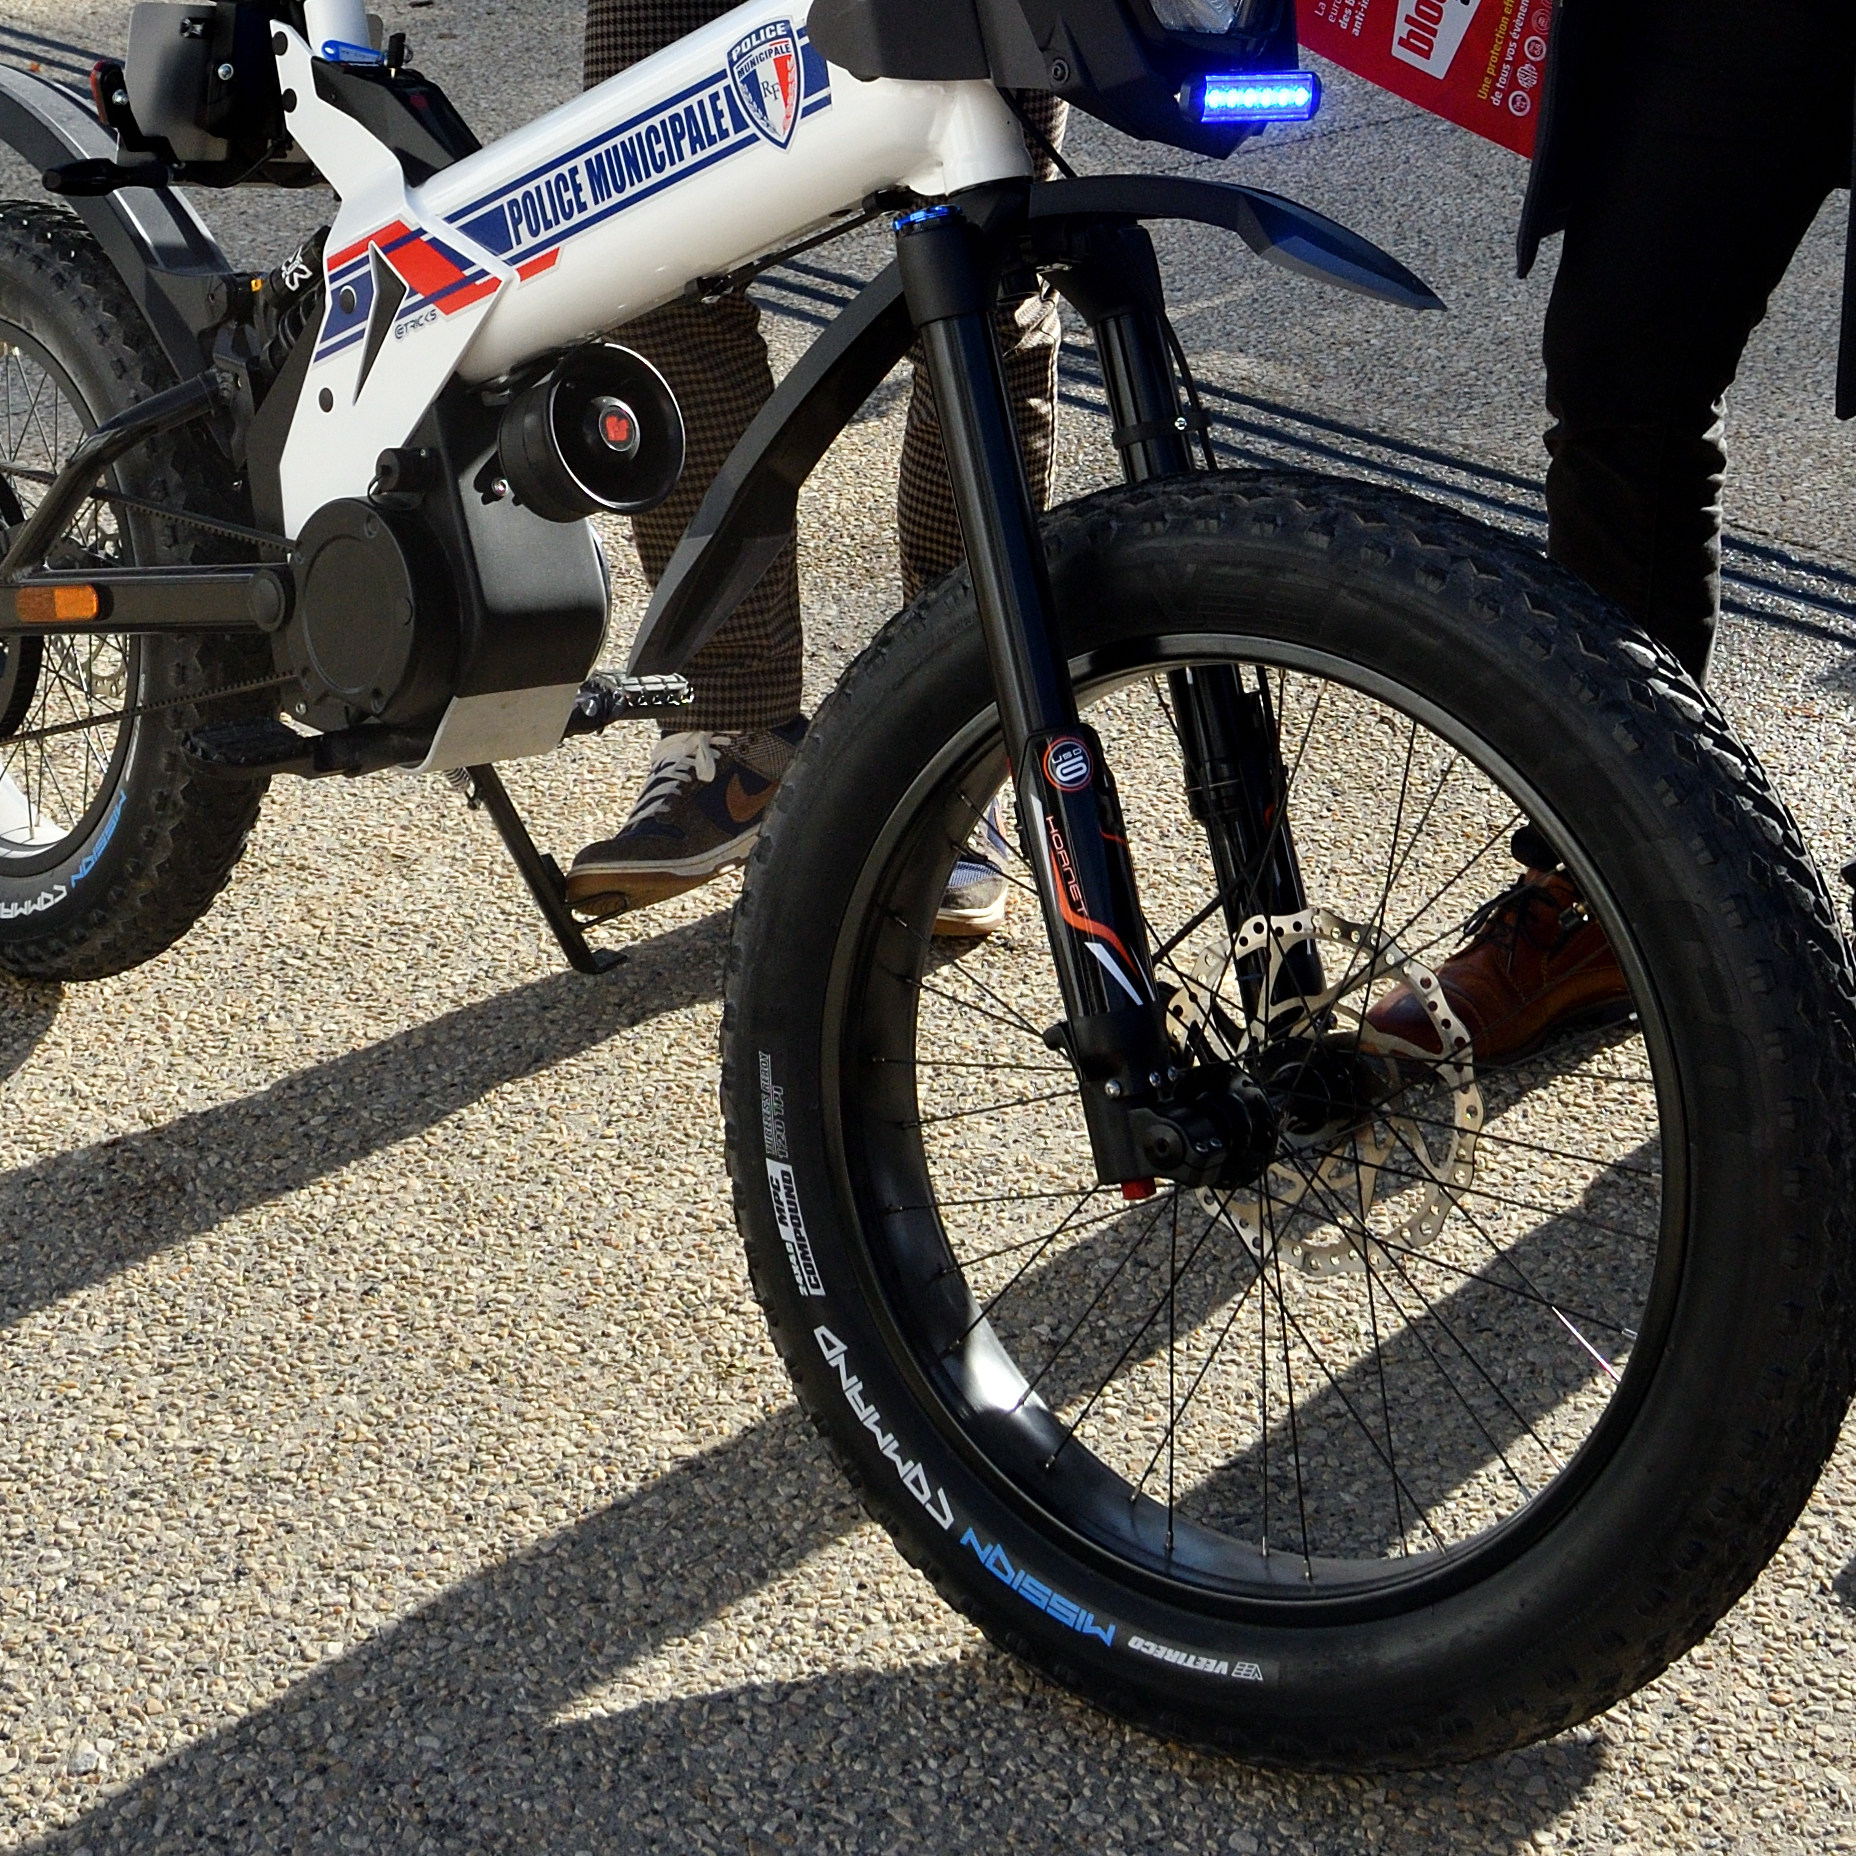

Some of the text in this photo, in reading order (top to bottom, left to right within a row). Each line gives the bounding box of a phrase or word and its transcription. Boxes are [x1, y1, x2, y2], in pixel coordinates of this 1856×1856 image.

[731, 22, 787, 62] POLICE
[1314, 3, 1326, 17] La
[1339, 9, 1352, 30] des
[737, 43, 792, 79] MUNICIPALE
[1477, 75, 1492, 101] Une
[1485, 16, 1509, 76] protection
[1492, 89, 1504, 107] de
[1499, 64, 1511, 90] tous
[1505, 41, 1518, 62] vos
[507, 91, 730, 246] POLICE MUNICIPALE
[1046, 815, 1089, 916] HORNET
[758, 1050, 771, 1094] READY
[772, 1084, 790, 1159] 120 TPI
[769, 1174, 789, 1227] MPC
[780, 1169, 822, 1291] COMPOUND
[813, 1324, 954, 1531] COMMAND
[960, 1526, 1117, 1647] MISSION
